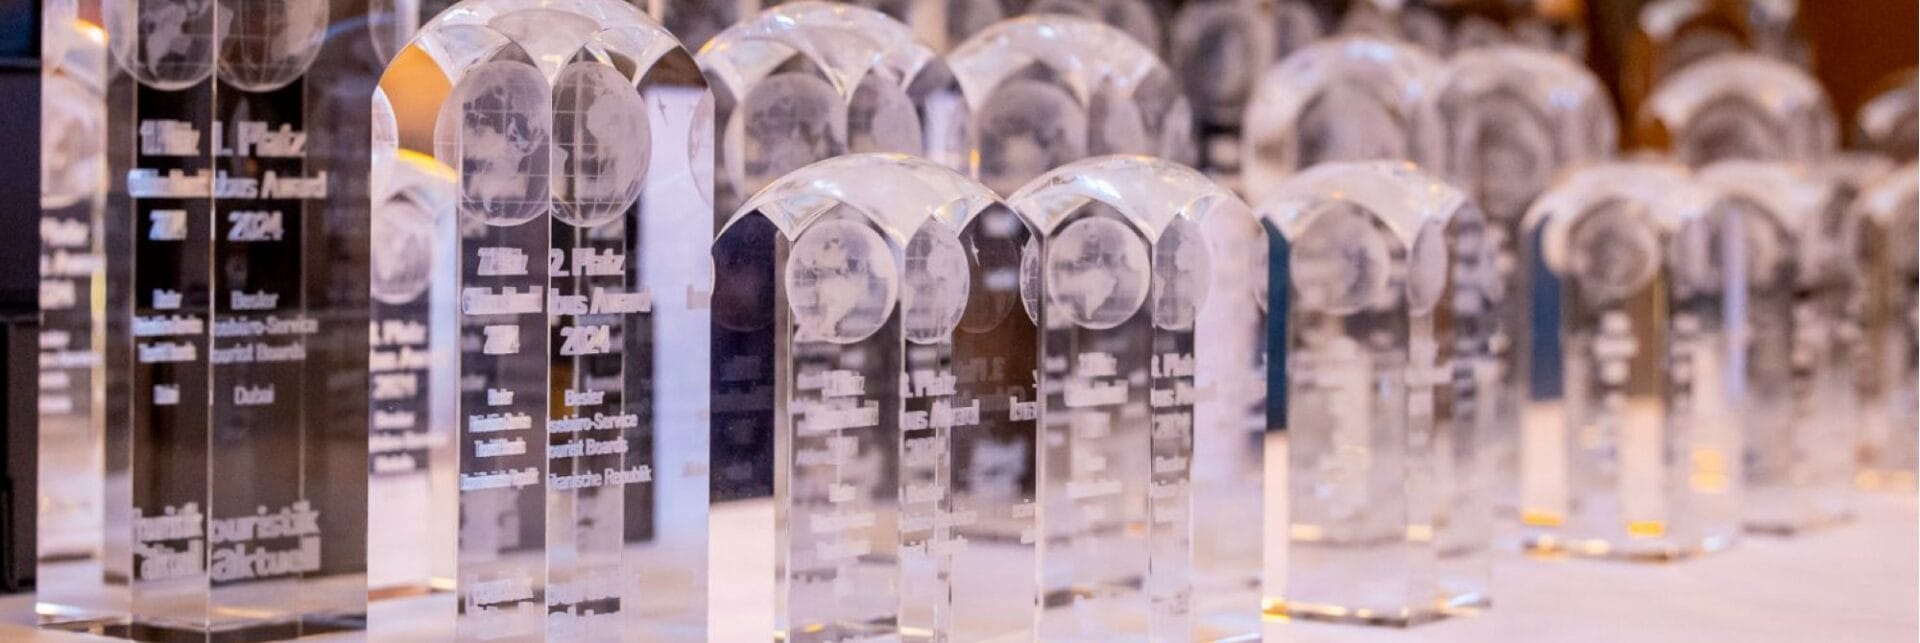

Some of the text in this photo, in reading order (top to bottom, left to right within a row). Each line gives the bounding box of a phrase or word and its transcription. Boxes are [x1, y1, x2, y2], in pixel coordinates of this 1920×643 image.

[237, 121, 307, 157] Platz
[261, 170, 327, 199] Award
[227, 211, 284, 241] 2024
[571, 248, 626, 277] Platz
[560, 325, 610, 356] 2024
[234, 385, 275, 406] Dubai
[586, 436, 629, 457] Boards
[604, 464, 652, 486] Republik
